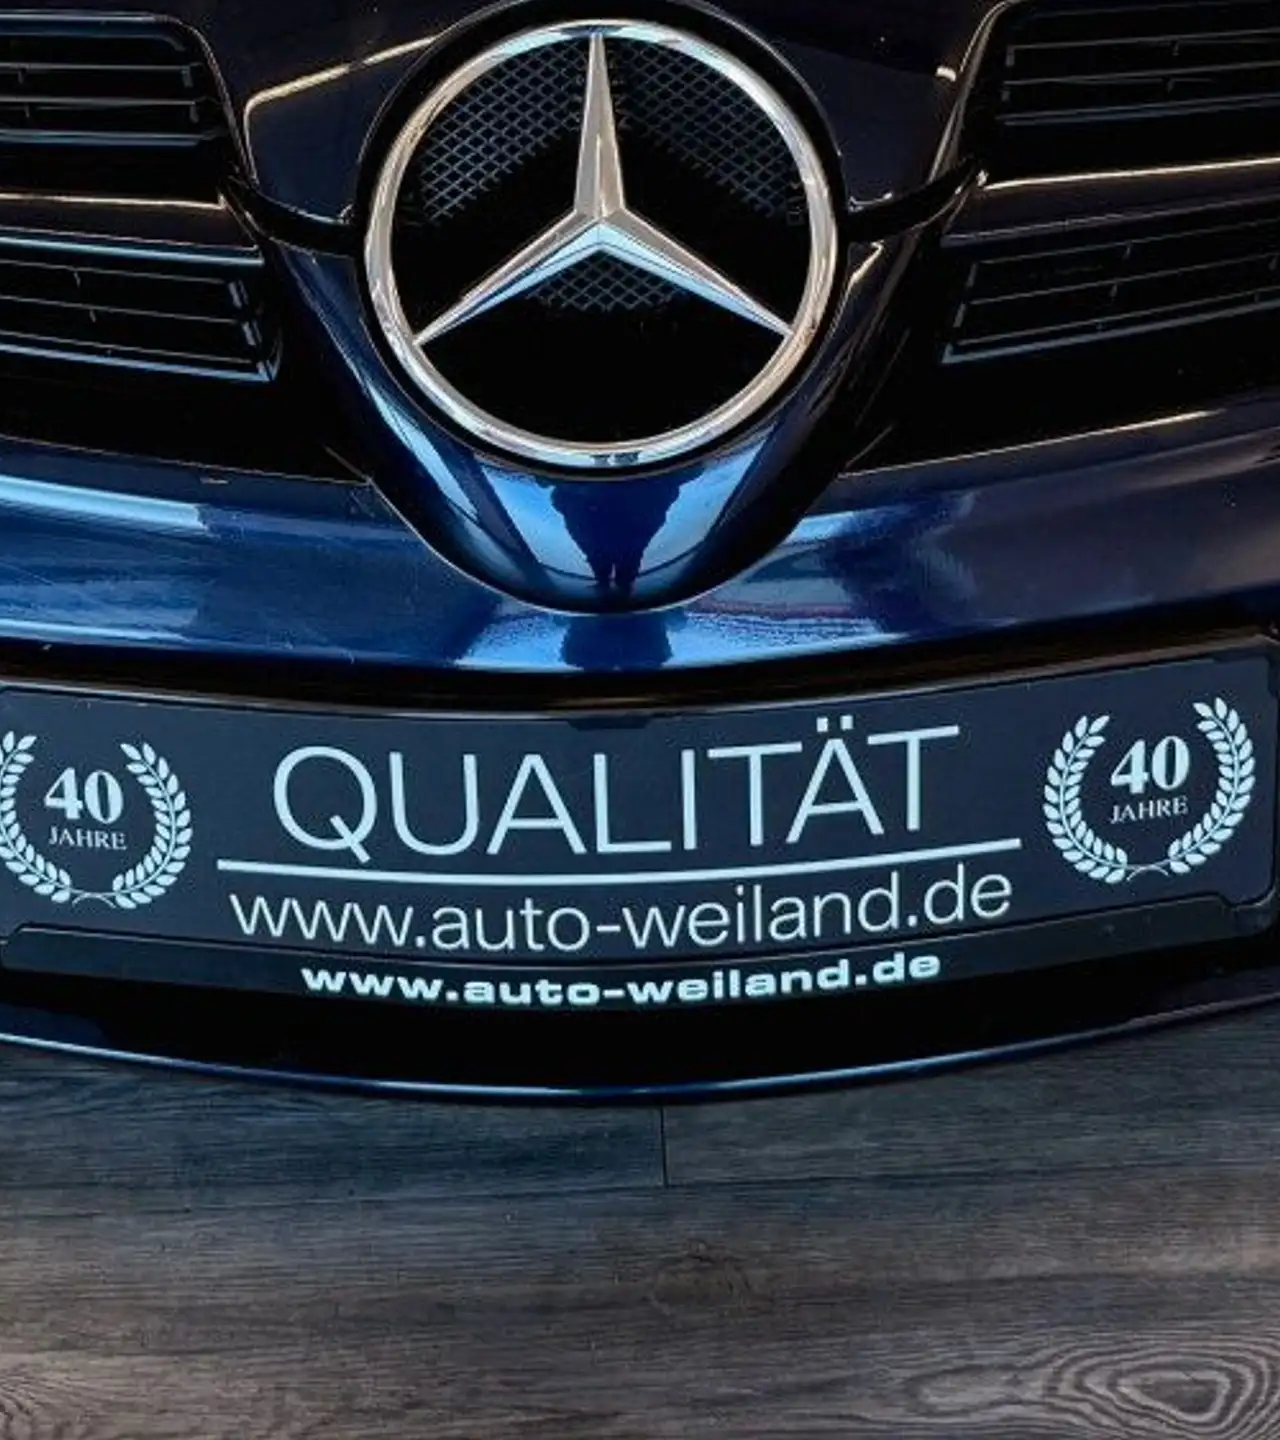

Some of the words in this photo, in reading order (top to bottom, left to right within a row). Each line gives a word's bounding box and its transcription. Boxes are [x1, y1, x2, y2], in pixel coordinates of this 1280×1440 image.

[273, 714, 960, 864] QUALITÄT
[1109, 735, 1191, 795] 40
[42, 766, 125, 826] 40
[1110, 794, 1188, 824] JAHRE
[48, 826, 126, 852] JAHRE
[229, 863, 1013, 953] www.auto-weiland.de
[301, 951, 942, 1006] www.auto-weiland.de
